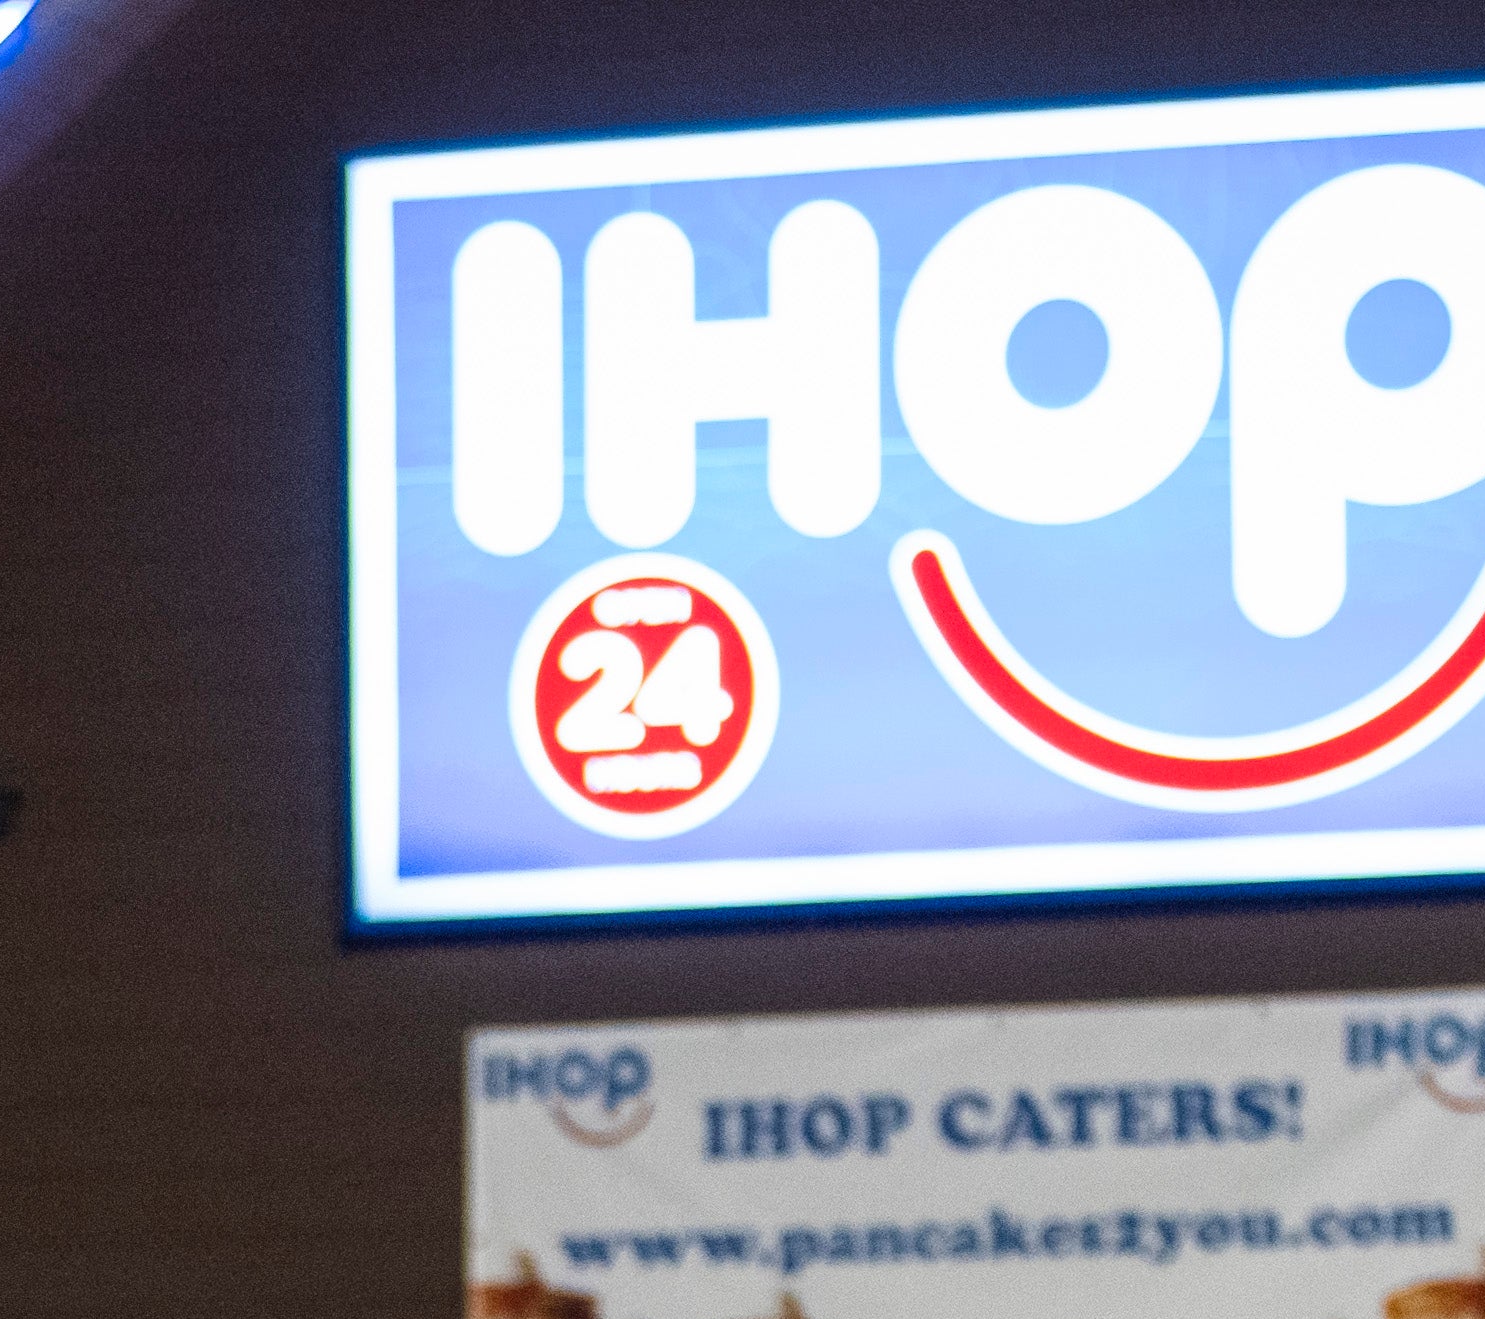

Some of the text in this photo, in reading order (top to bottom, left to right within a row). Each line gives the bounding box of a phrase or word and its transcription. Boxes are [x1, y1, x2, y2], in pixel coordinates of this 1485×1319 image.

[555, 624, 735, 753] 24
[481, 1045, 652, 1113] IHOP
[702, 1077, 1306, 1163] IHOP CATERS!
[560, 1203, 1454, 1275] www.pancakes2you.com
